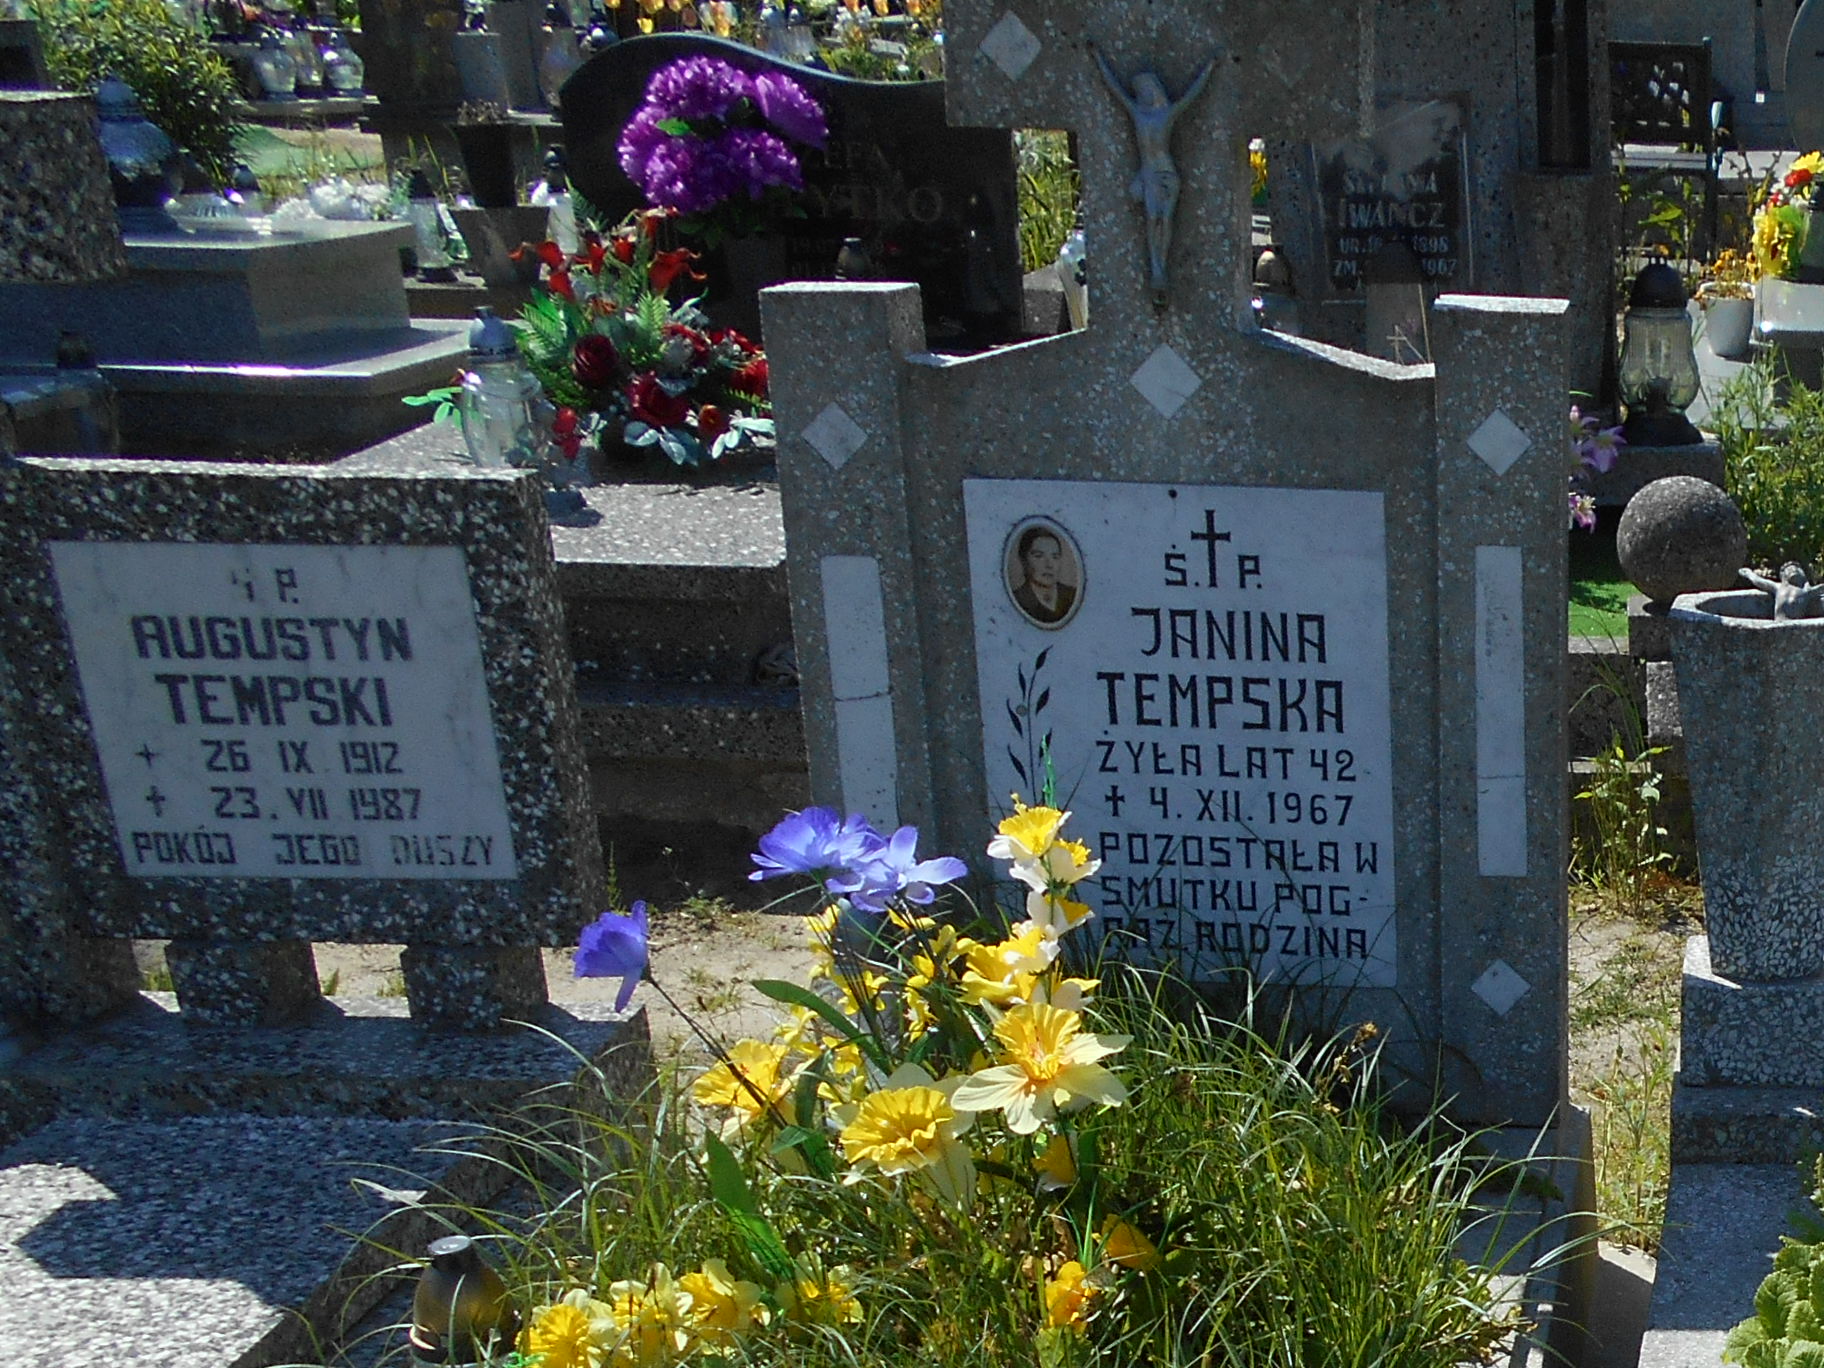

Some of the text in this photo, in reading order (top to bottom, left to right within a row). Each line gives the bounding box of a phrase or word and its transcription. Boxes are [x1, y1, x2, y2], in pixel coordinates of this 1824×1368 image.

[130, 615, 414, 662] AUGUSTYN
[1130, 606, 1328, 664] JANINA
[155, 673, 394, 727] TEMPSKI
[1096, 671, 1346, 734] TEMPSKA
[201, 739, 404, 775] 26 IX 1912
[1095, 729, 1358, 783] ŻYŁA LAT 42
[349, 787, 422, 821] 1987
[1266, 791, 1355, 828] 1967
[131, 825, 494, 867] POKÓJ JEGO DUSZY
[1099, 831, 1378, 874] POZOSTAŁA W
[1100, 875, 1258, 913] SMUTKU
[1195, 919, 1368, 960] RODZINA
